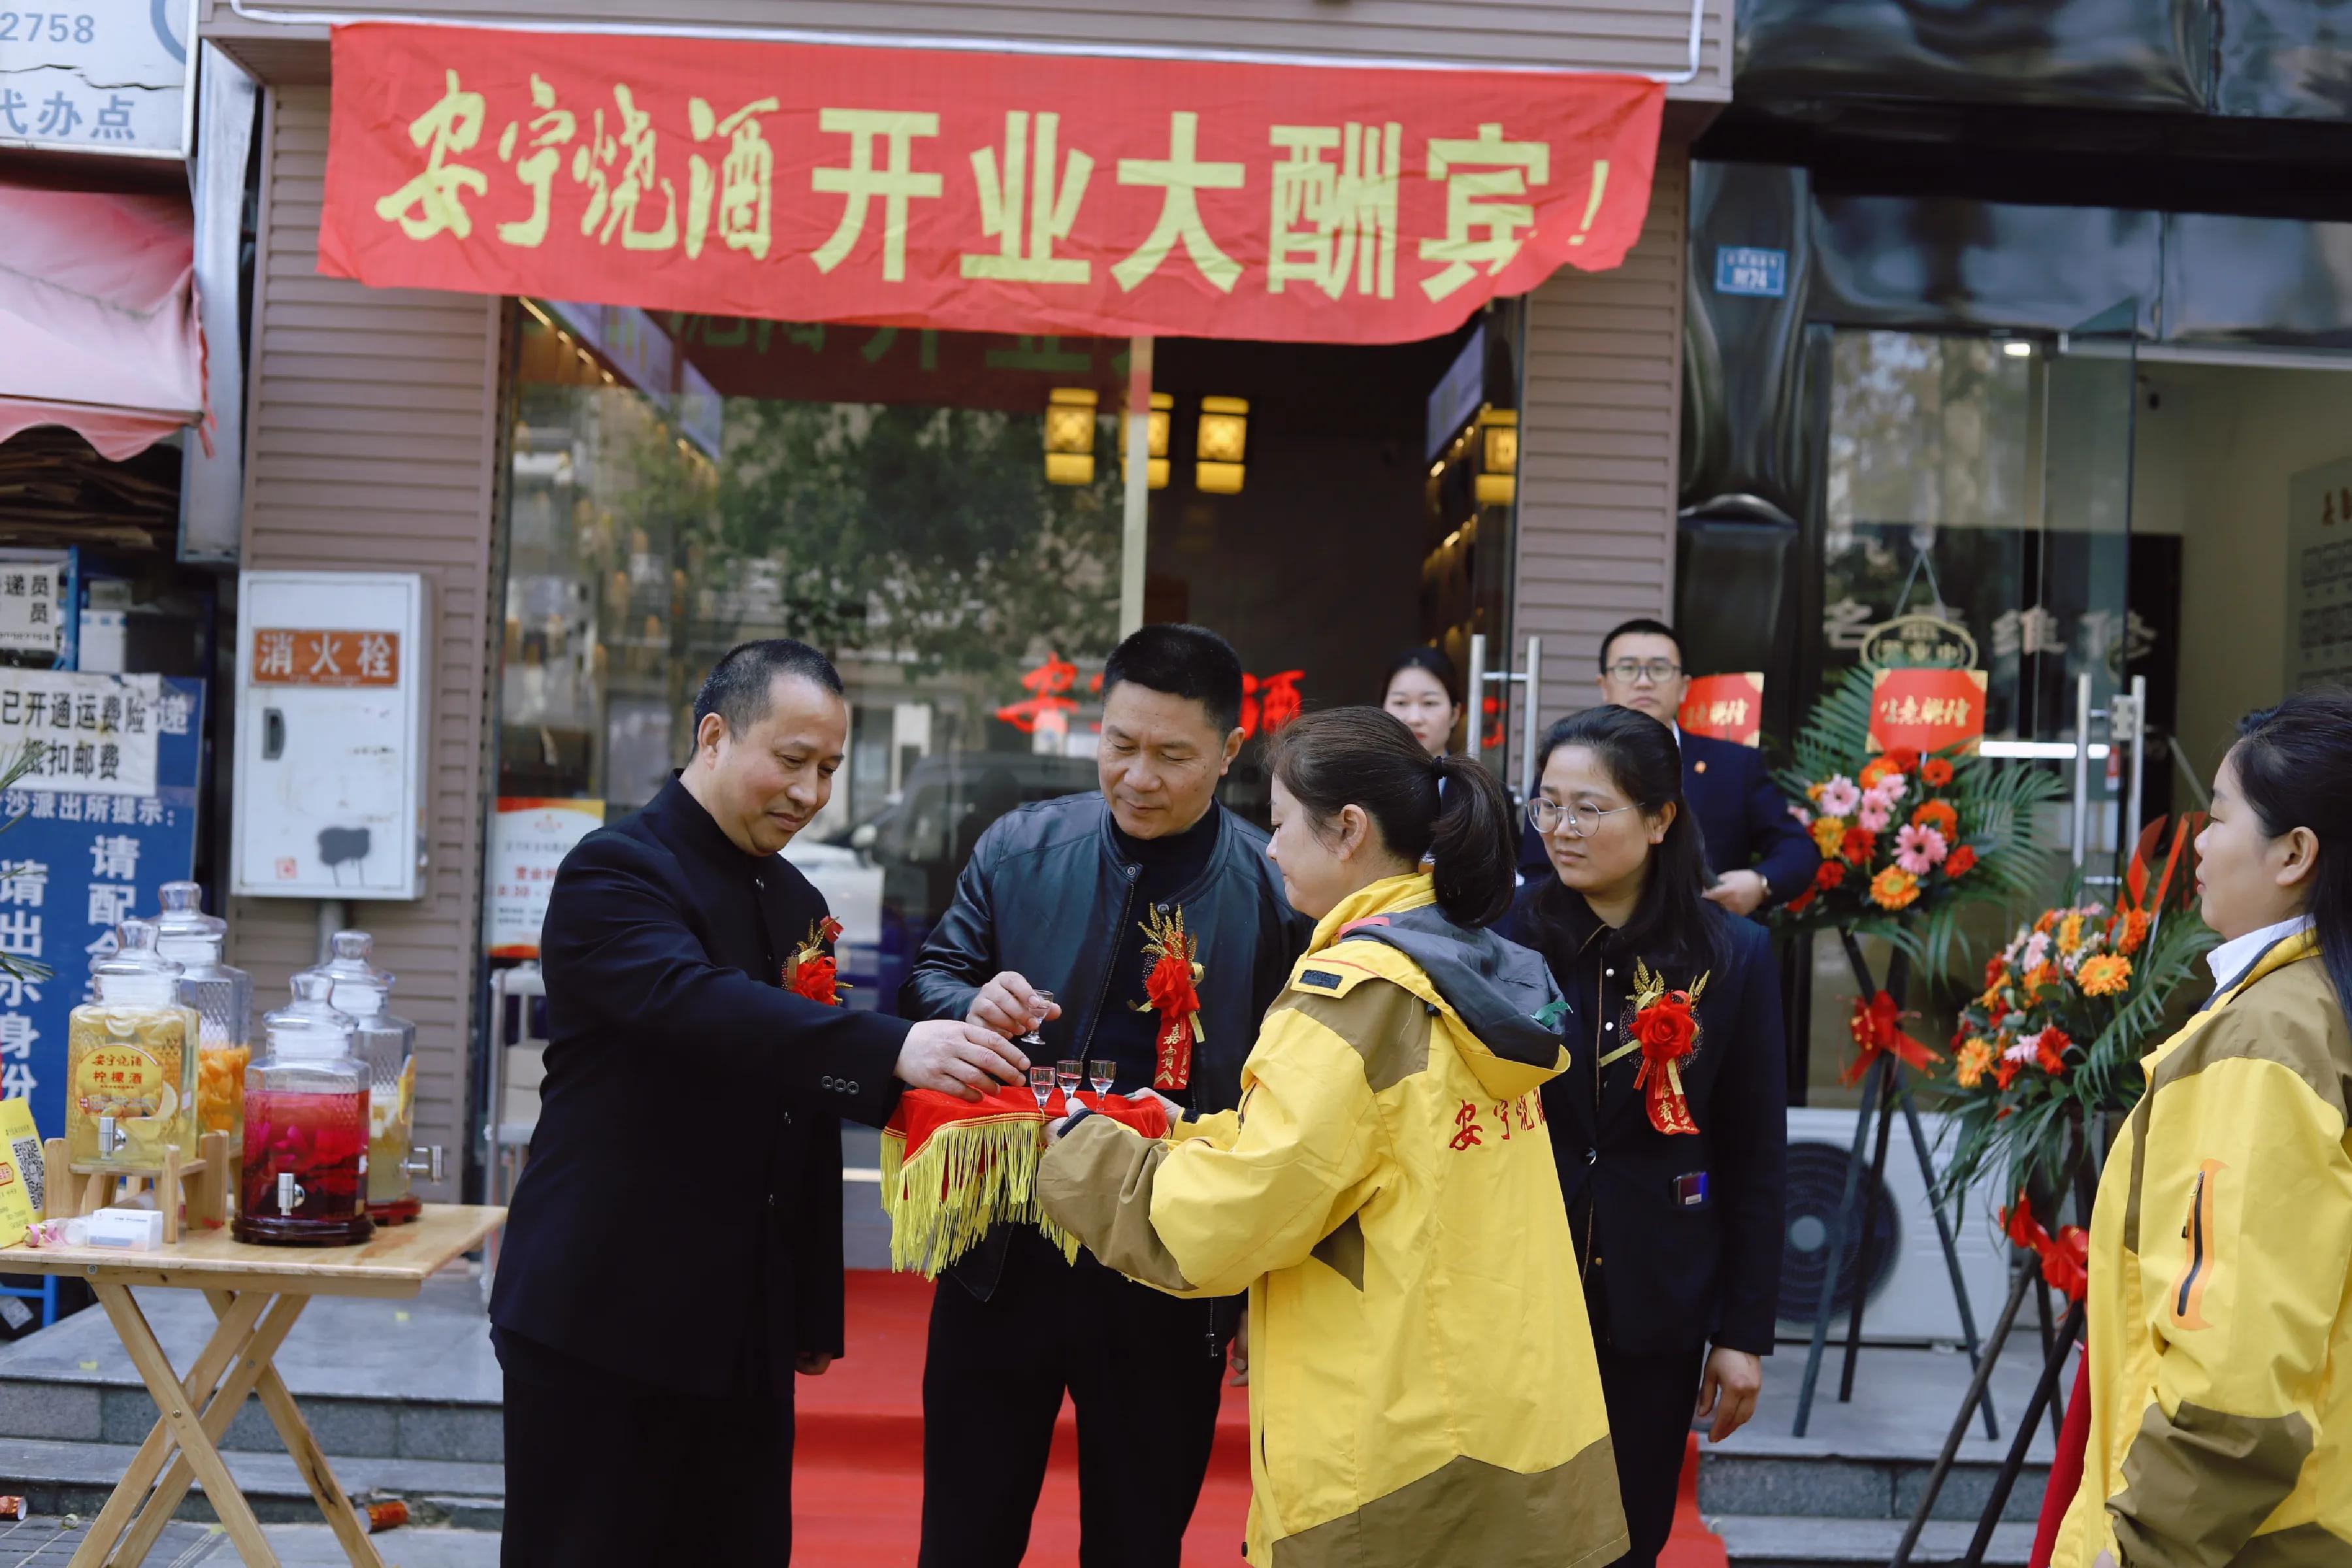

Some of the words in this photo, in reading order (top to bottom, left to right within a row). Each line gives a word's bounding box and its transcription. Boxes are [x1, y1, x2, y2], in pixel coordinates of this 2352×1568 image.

[260, 632, 391, 678] 消火栓
[2, 689, 148, 734] 已开通运费险
[93, 1071, 142, 1085] 柠檬酒
